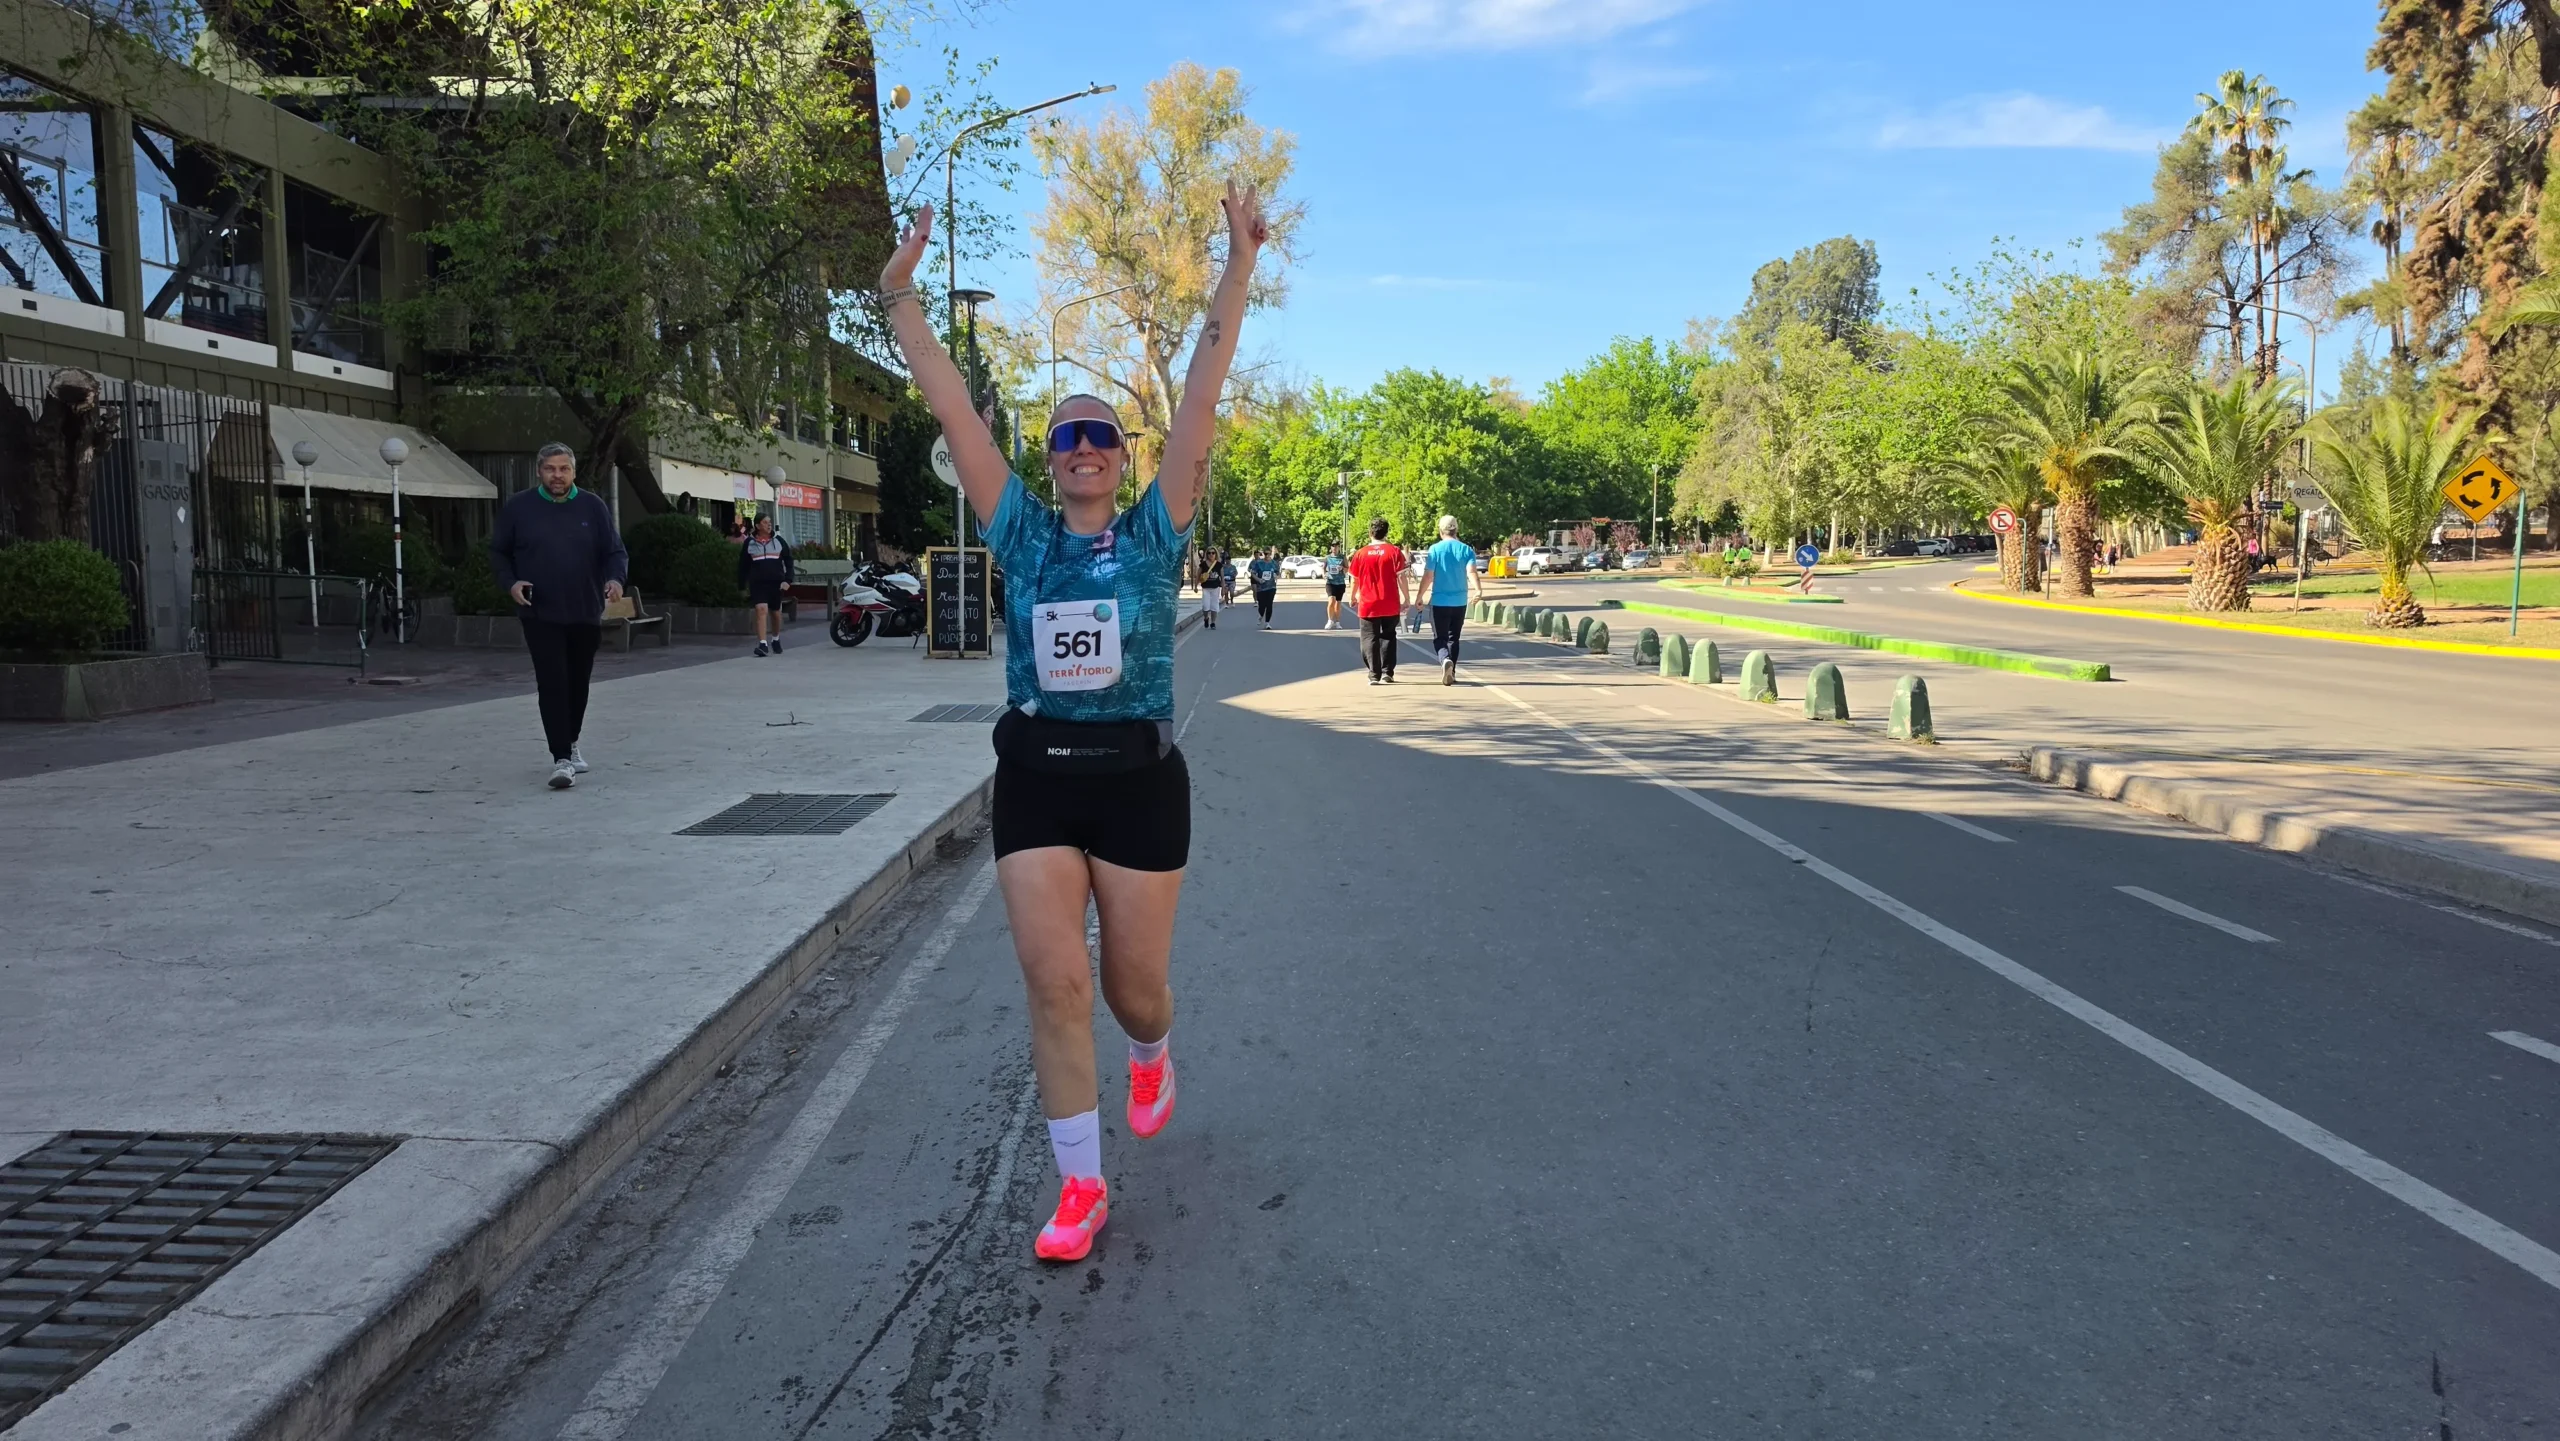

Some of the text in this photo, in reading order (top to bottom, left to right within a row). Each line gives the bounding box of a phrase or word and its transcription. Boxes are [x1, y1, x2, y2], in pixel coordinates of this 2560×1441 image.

[144, 484, 170, 501] GAS
[171, 485, 189, 501] GAS
[1053, 629, 1102, 660] 561
[1049, 663, 1113, 679] TERRITORIO
